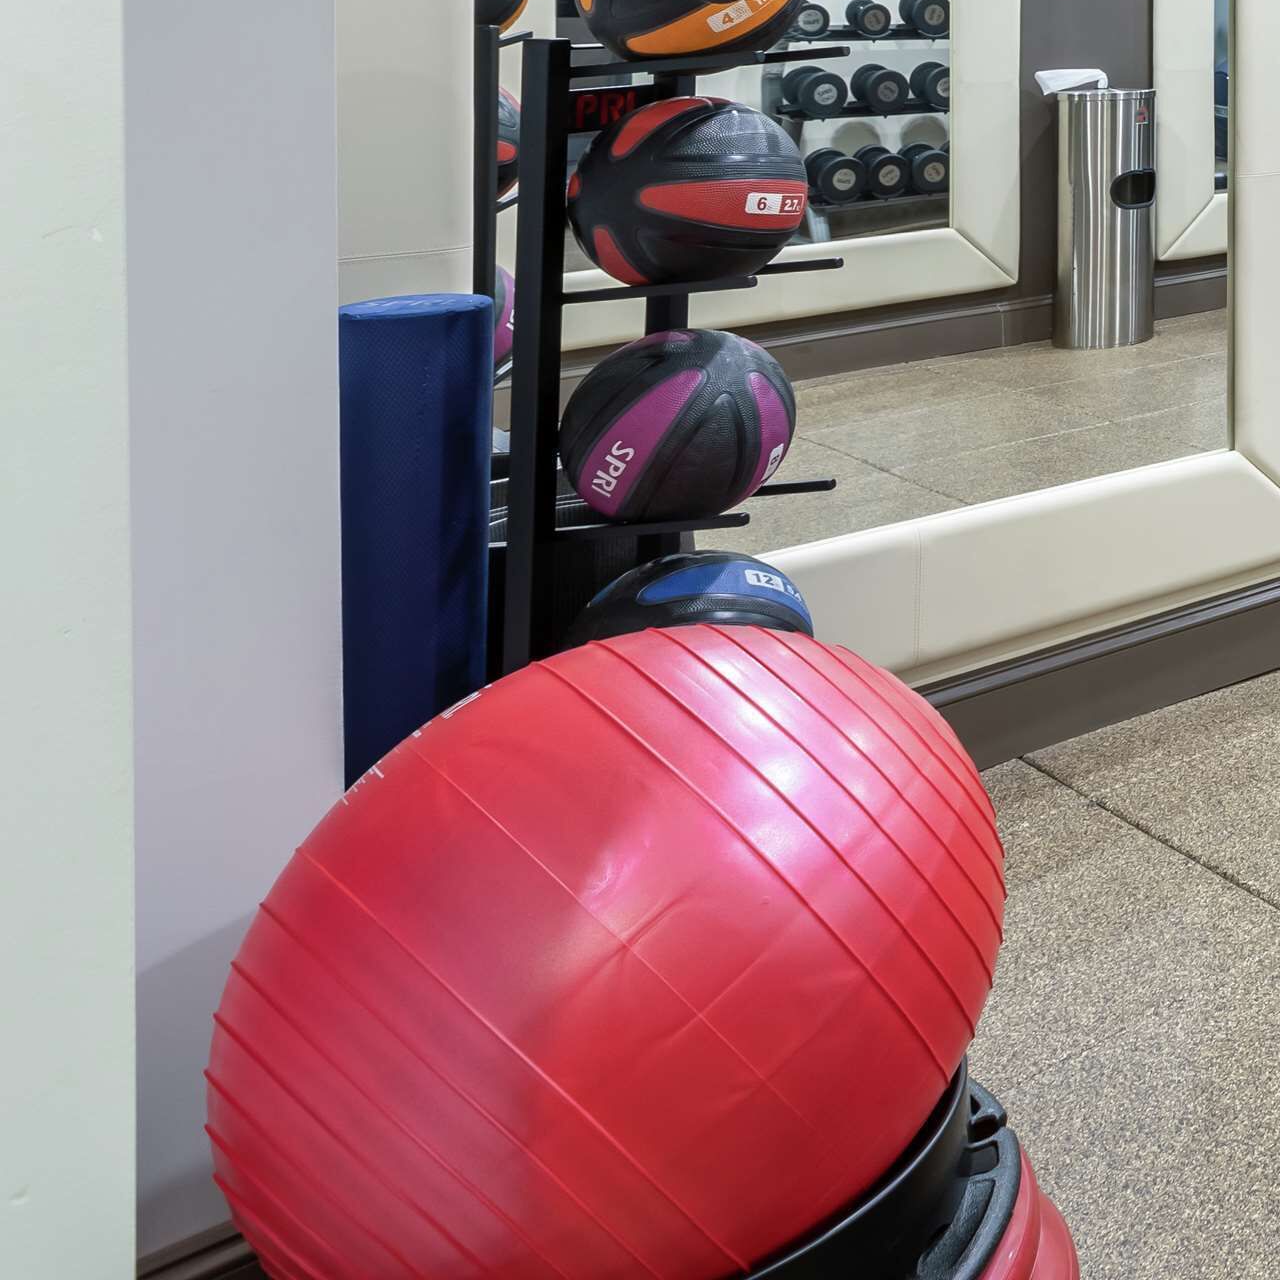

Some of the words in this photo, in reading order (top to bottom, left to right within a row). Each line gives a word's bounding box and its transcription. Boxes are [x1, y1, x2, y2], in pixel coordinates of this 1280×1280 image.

[721, 11, 735, 25] 4
[575, 91, 637, 127] PRI
[757, 196, 768, 211] 6
[591, 440, 635, 498] SPRI
[752, 572, 774, 586] 12
